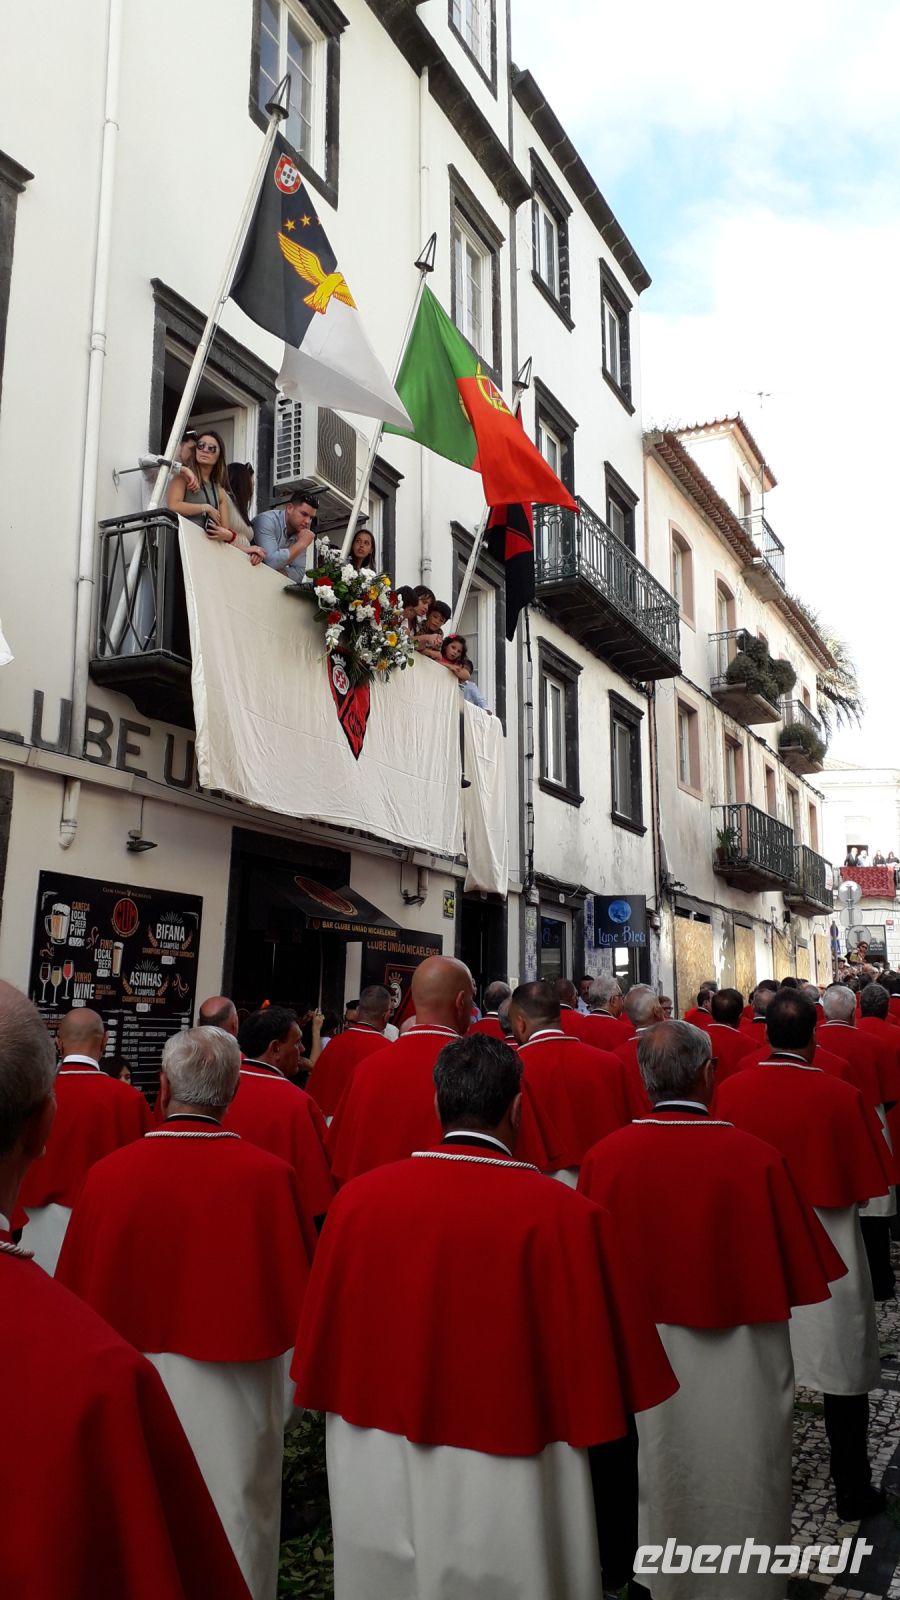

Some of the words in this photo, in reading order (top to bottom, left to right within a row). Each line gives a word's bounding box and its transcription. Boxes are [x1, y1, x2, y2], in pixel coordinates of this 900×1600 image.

[0, 690, 151, 778] UBE
[71, 910, 87, 922] LOCAL
[70, 924, 86, 937] PINT
[75, 920, 87, 928] BEER
[322, 920, 333, 929] BAR
[334, 922, 351, 931] CLUBE
[352, 923, 368, 933] UNIÃO
[368, 927, 397, 937] MICAELENSE
[155, 923, 185, 942] BIFANA
[598, 927, 618, 946] Lune
[621, 925, 646, 945] Bleu
[367, 941, 387, 951] CLUBE
[387, 940, 406, 954] UNIÃO
[94, 949, 112, 962] LOCAL
[98, 959, 112, 969] BEER
[129, 972, 162, 987] ASINHAS
[74, 983, 95, 999] WINE
